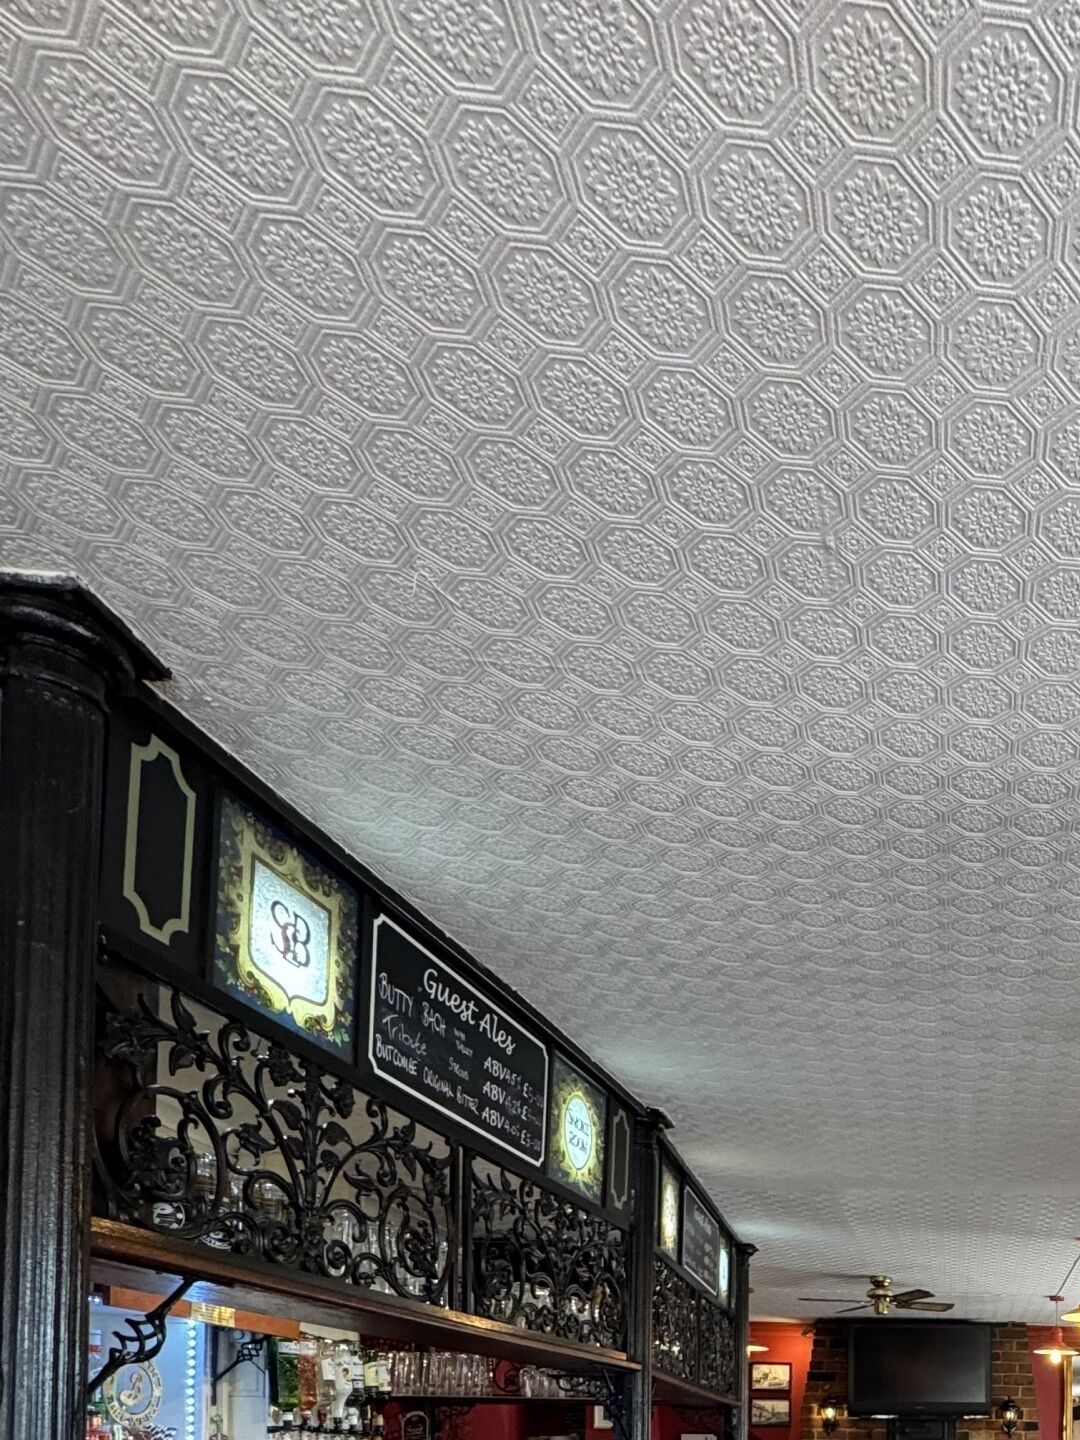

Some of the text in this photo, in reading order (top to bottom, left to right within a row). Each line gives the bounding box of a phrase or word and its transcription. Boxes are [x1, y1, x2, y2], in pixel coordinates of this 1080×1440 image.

[379, 972, 413, 1018] BUTTY
[420, 1001, 446, 1038] BACH
[484, 1057, 506, 1083] ABV
[423, 968, 517, 1055] Guest Ales
[382, 1014, 428, 1057] Tribute
[482, 1081, 506, 1108] ABV
[481, 1106, 505, 1130] ABV
